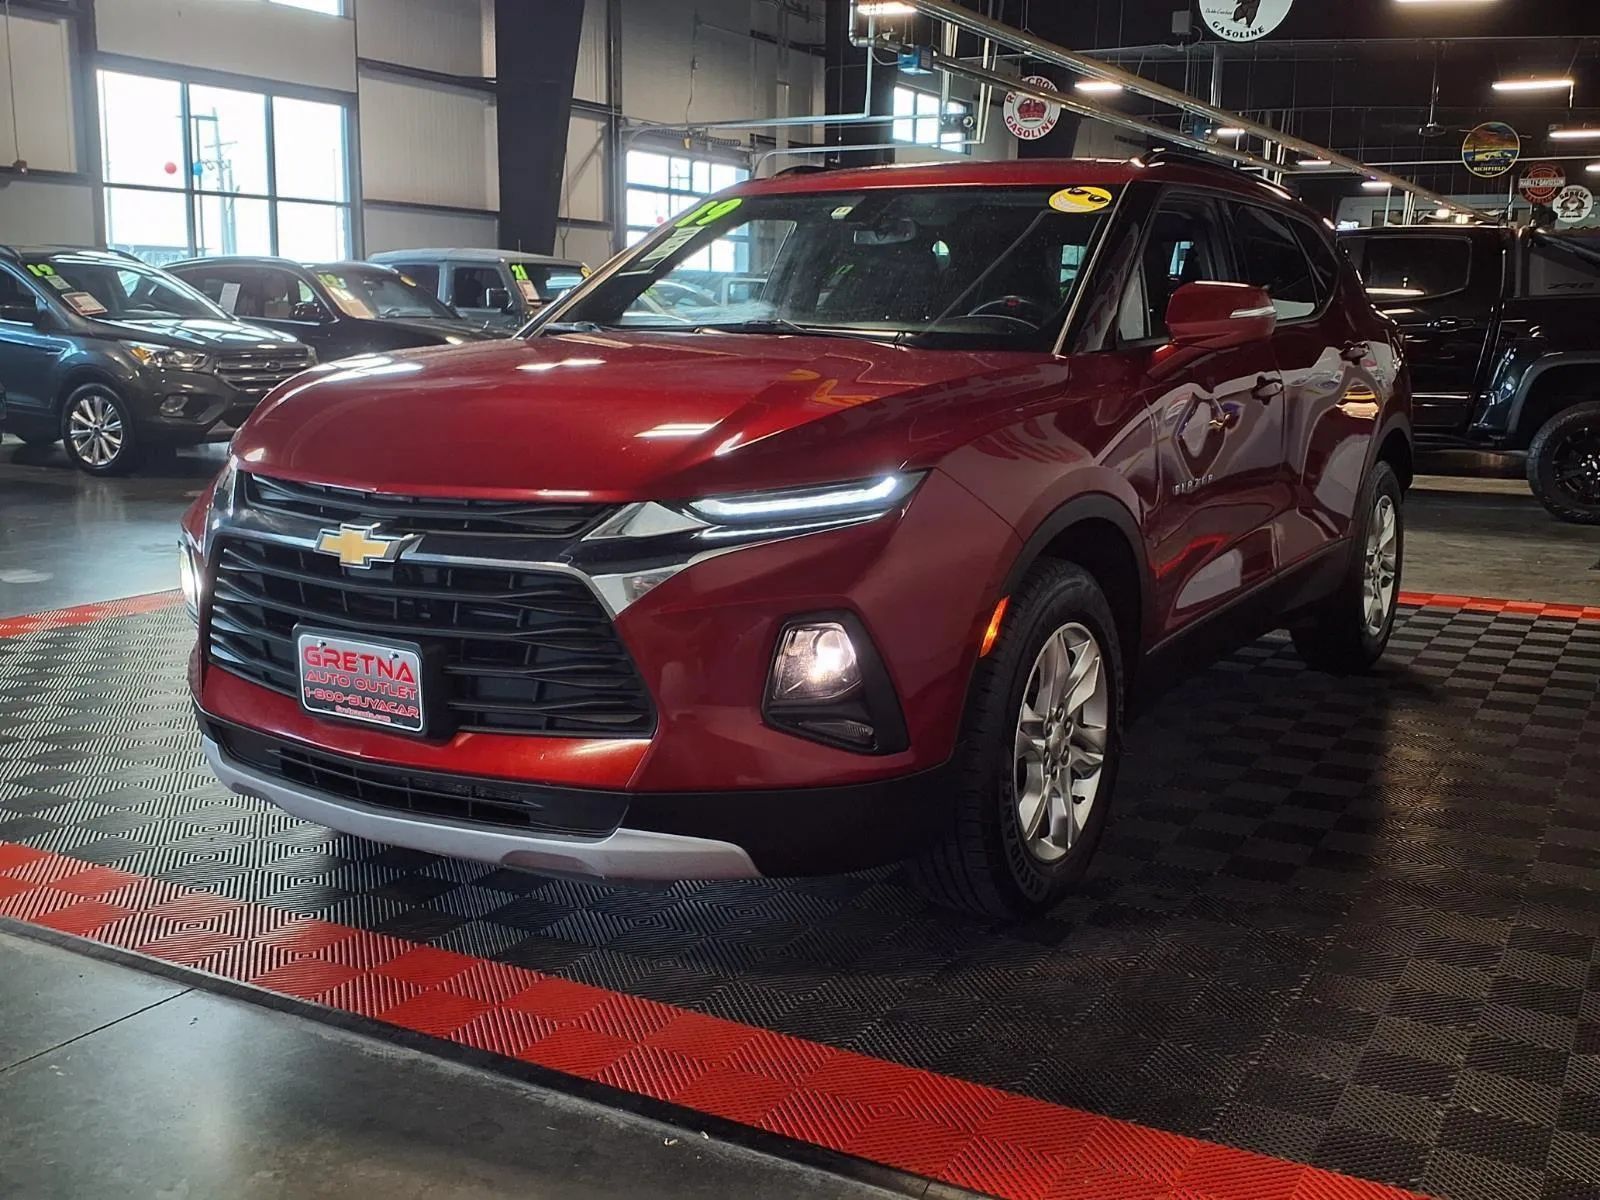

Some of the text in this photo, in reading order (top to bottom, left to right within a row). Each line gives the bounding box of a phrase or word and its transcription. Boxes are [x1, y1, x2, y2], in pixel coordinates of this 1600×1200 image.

[1212, 20, 1265, 38] GASOLINE
[1006, 115, 1056, 138] GASOLINE
[1520, 178, 1565, 187] HARLEY-DAVIDSON
[674, 198, 743, 228] 19
[26, 263, 55, 277] 19
[304, 645, 416, 684] GRETNA
[304, 670, 418, 701] AUTO OUTLET
[304, 686, 419, 719] 1-800-BUYACAR
